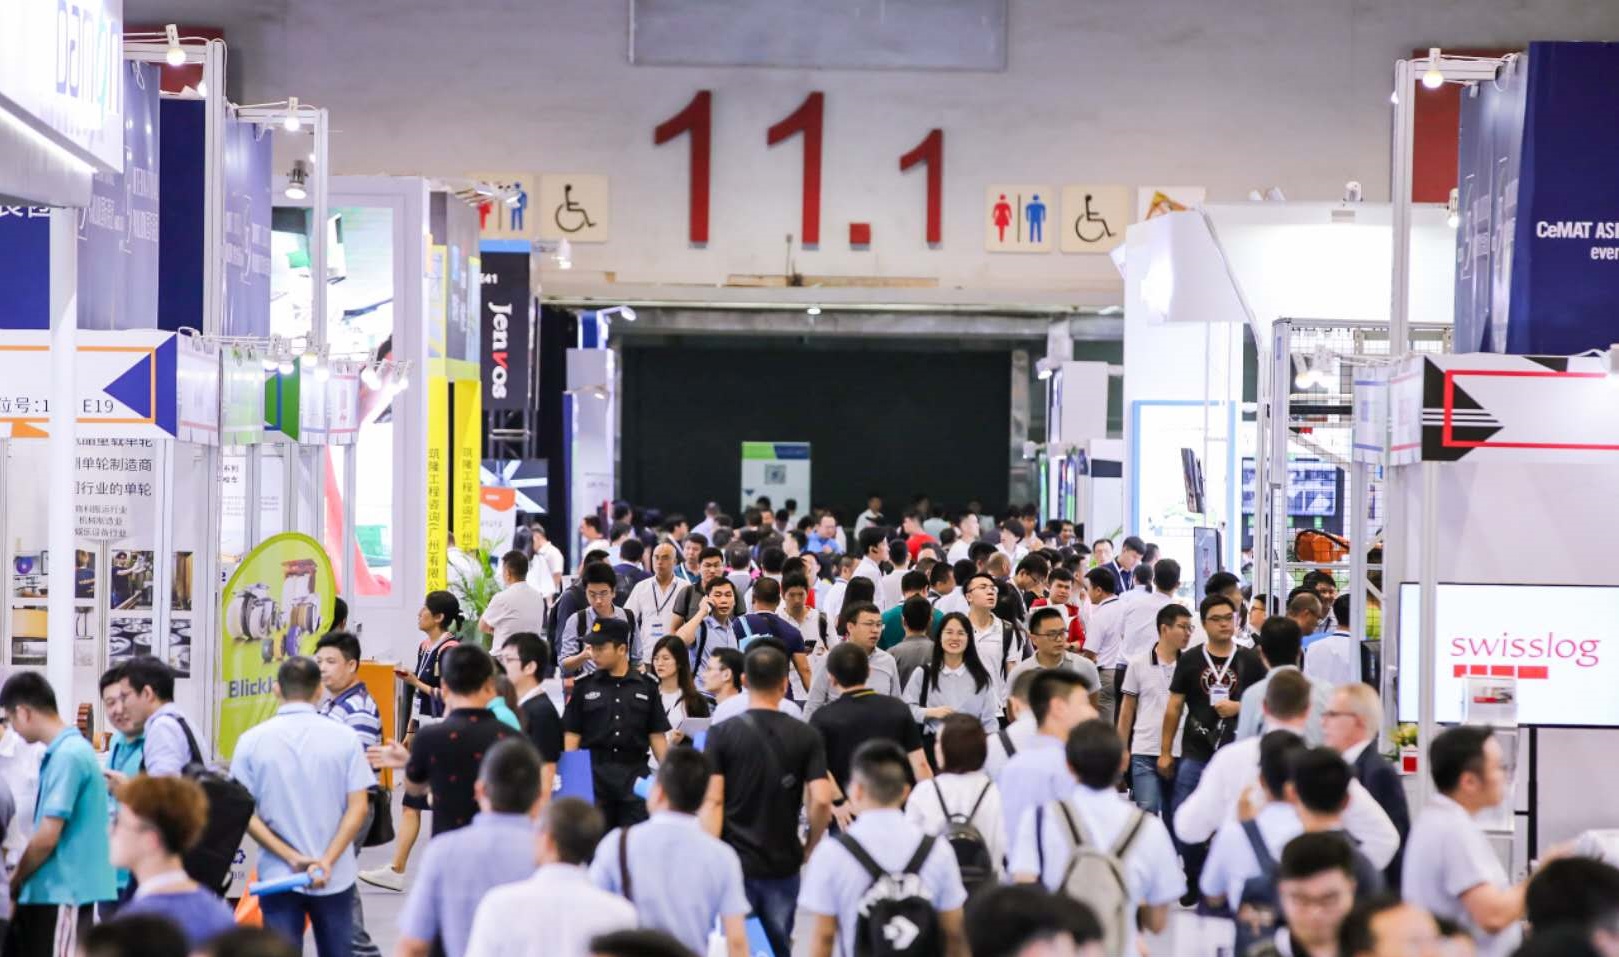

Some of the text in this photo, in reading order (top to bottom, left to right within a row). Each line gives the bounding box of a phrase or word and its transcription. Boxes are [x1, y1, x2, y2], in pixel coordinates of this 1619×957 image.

[653, 89, 943, 247] 11.1
[1536, 221, 1593, 238] CeMAT
[83, 399, 114, 413] E19
[1451, 632, 1601, 667] swisslog
